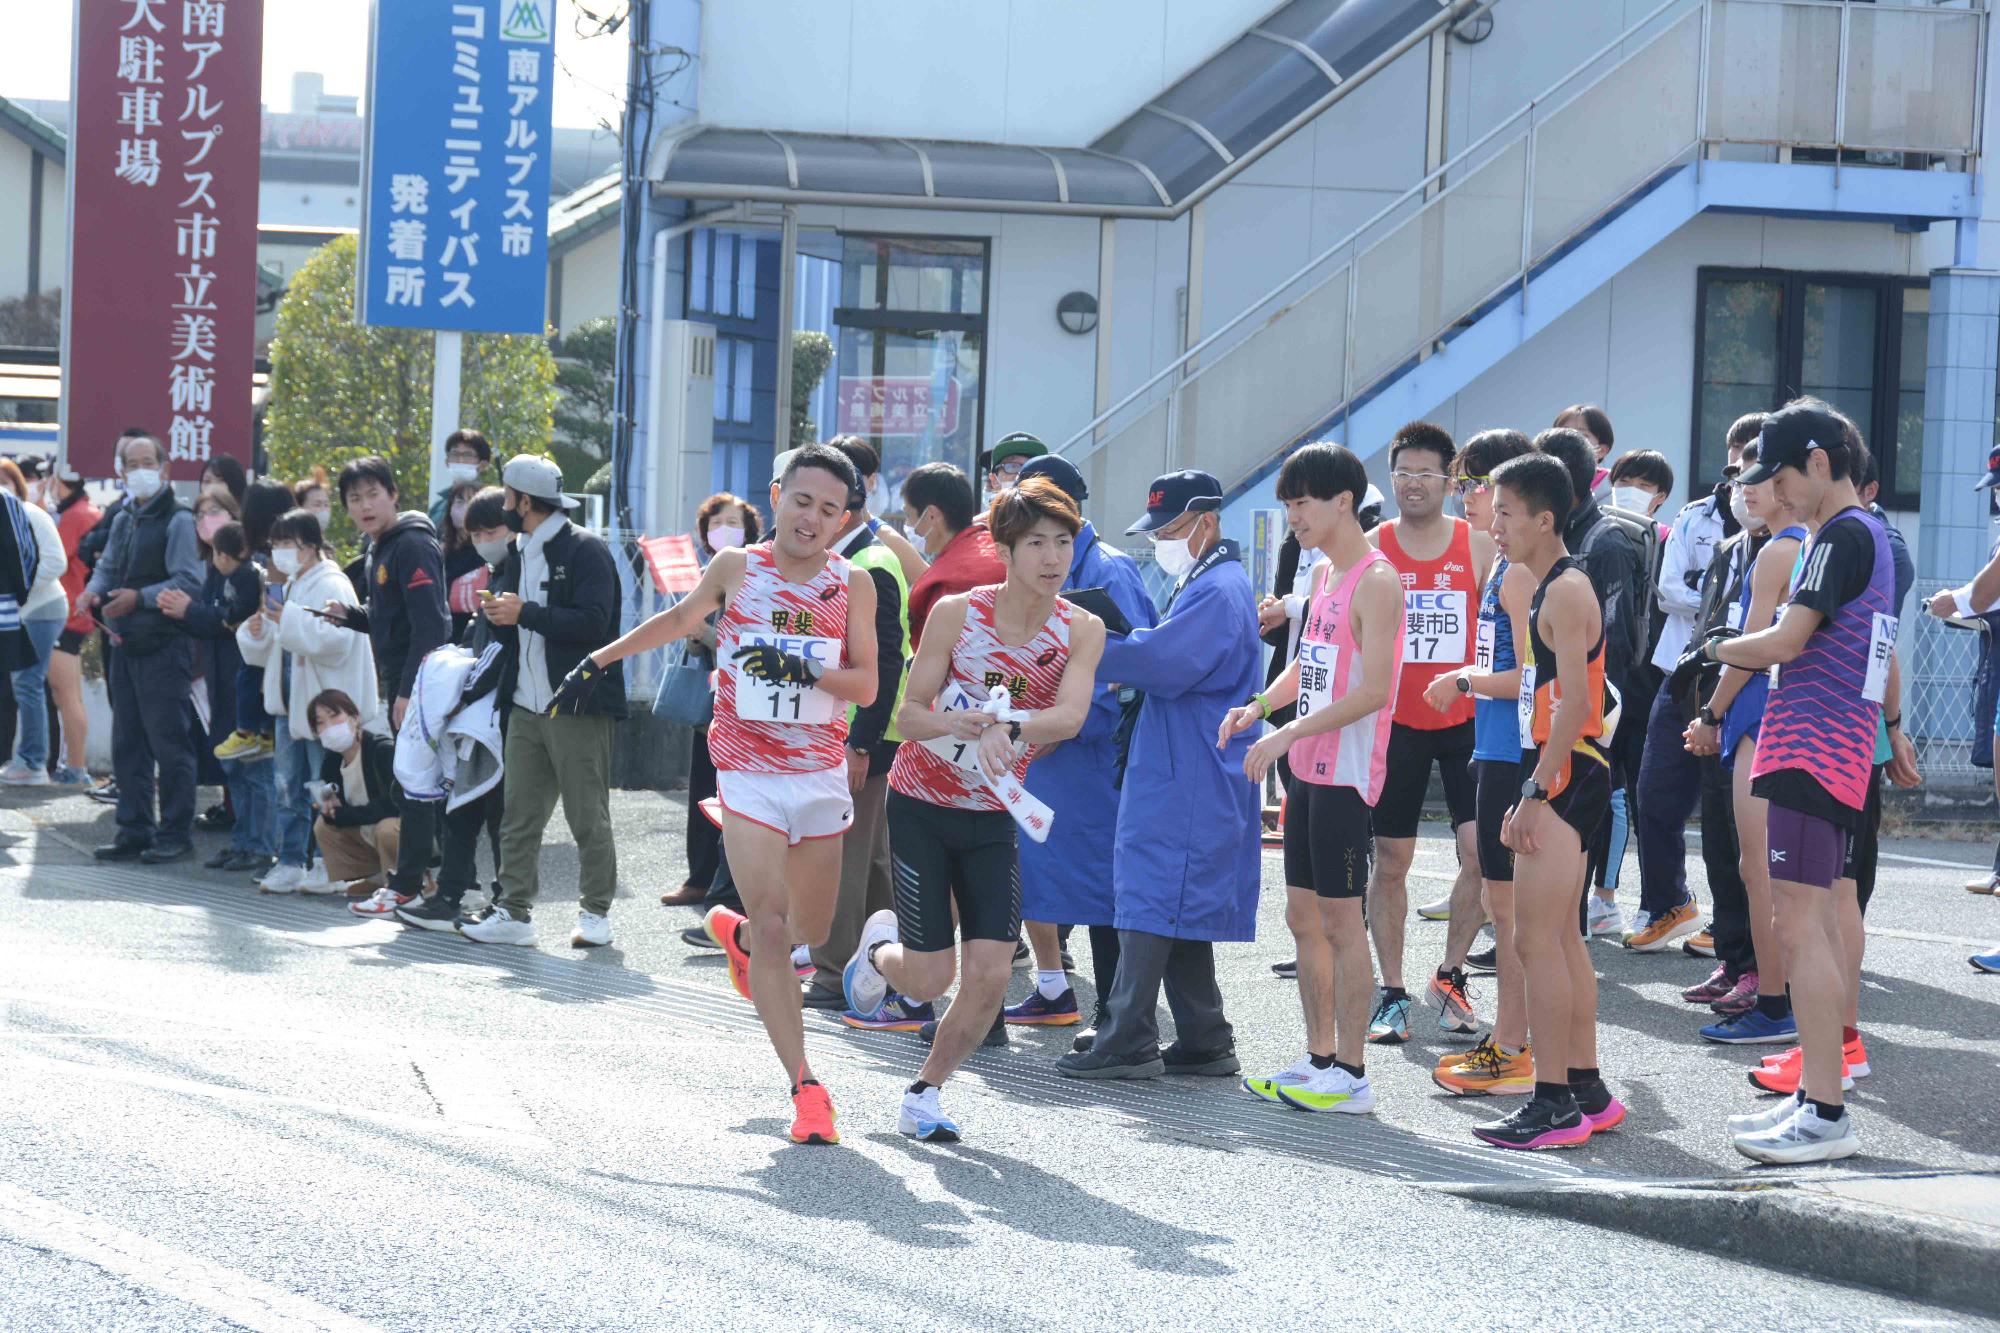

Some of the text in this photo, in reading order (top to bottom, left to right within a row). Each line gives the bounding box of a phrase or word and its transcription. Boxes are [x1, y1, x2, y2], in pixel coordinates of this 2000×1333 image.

[114, 0, 167, 187] 大駐車場
[438, 4, 485, 308] コミュニティバス
[500, 48, 542, 257] 南アルプス市
[168, 0, 226, 463] 南アルプス市立美術館
[385, 173, 429, 307] 発着所
[771, 609, 814, 636] 甲斐
[1299, 664, 1328, 692] 留郡
[1409, 637, 1440, 660] 17
[768, 691, 802, 720] 11
